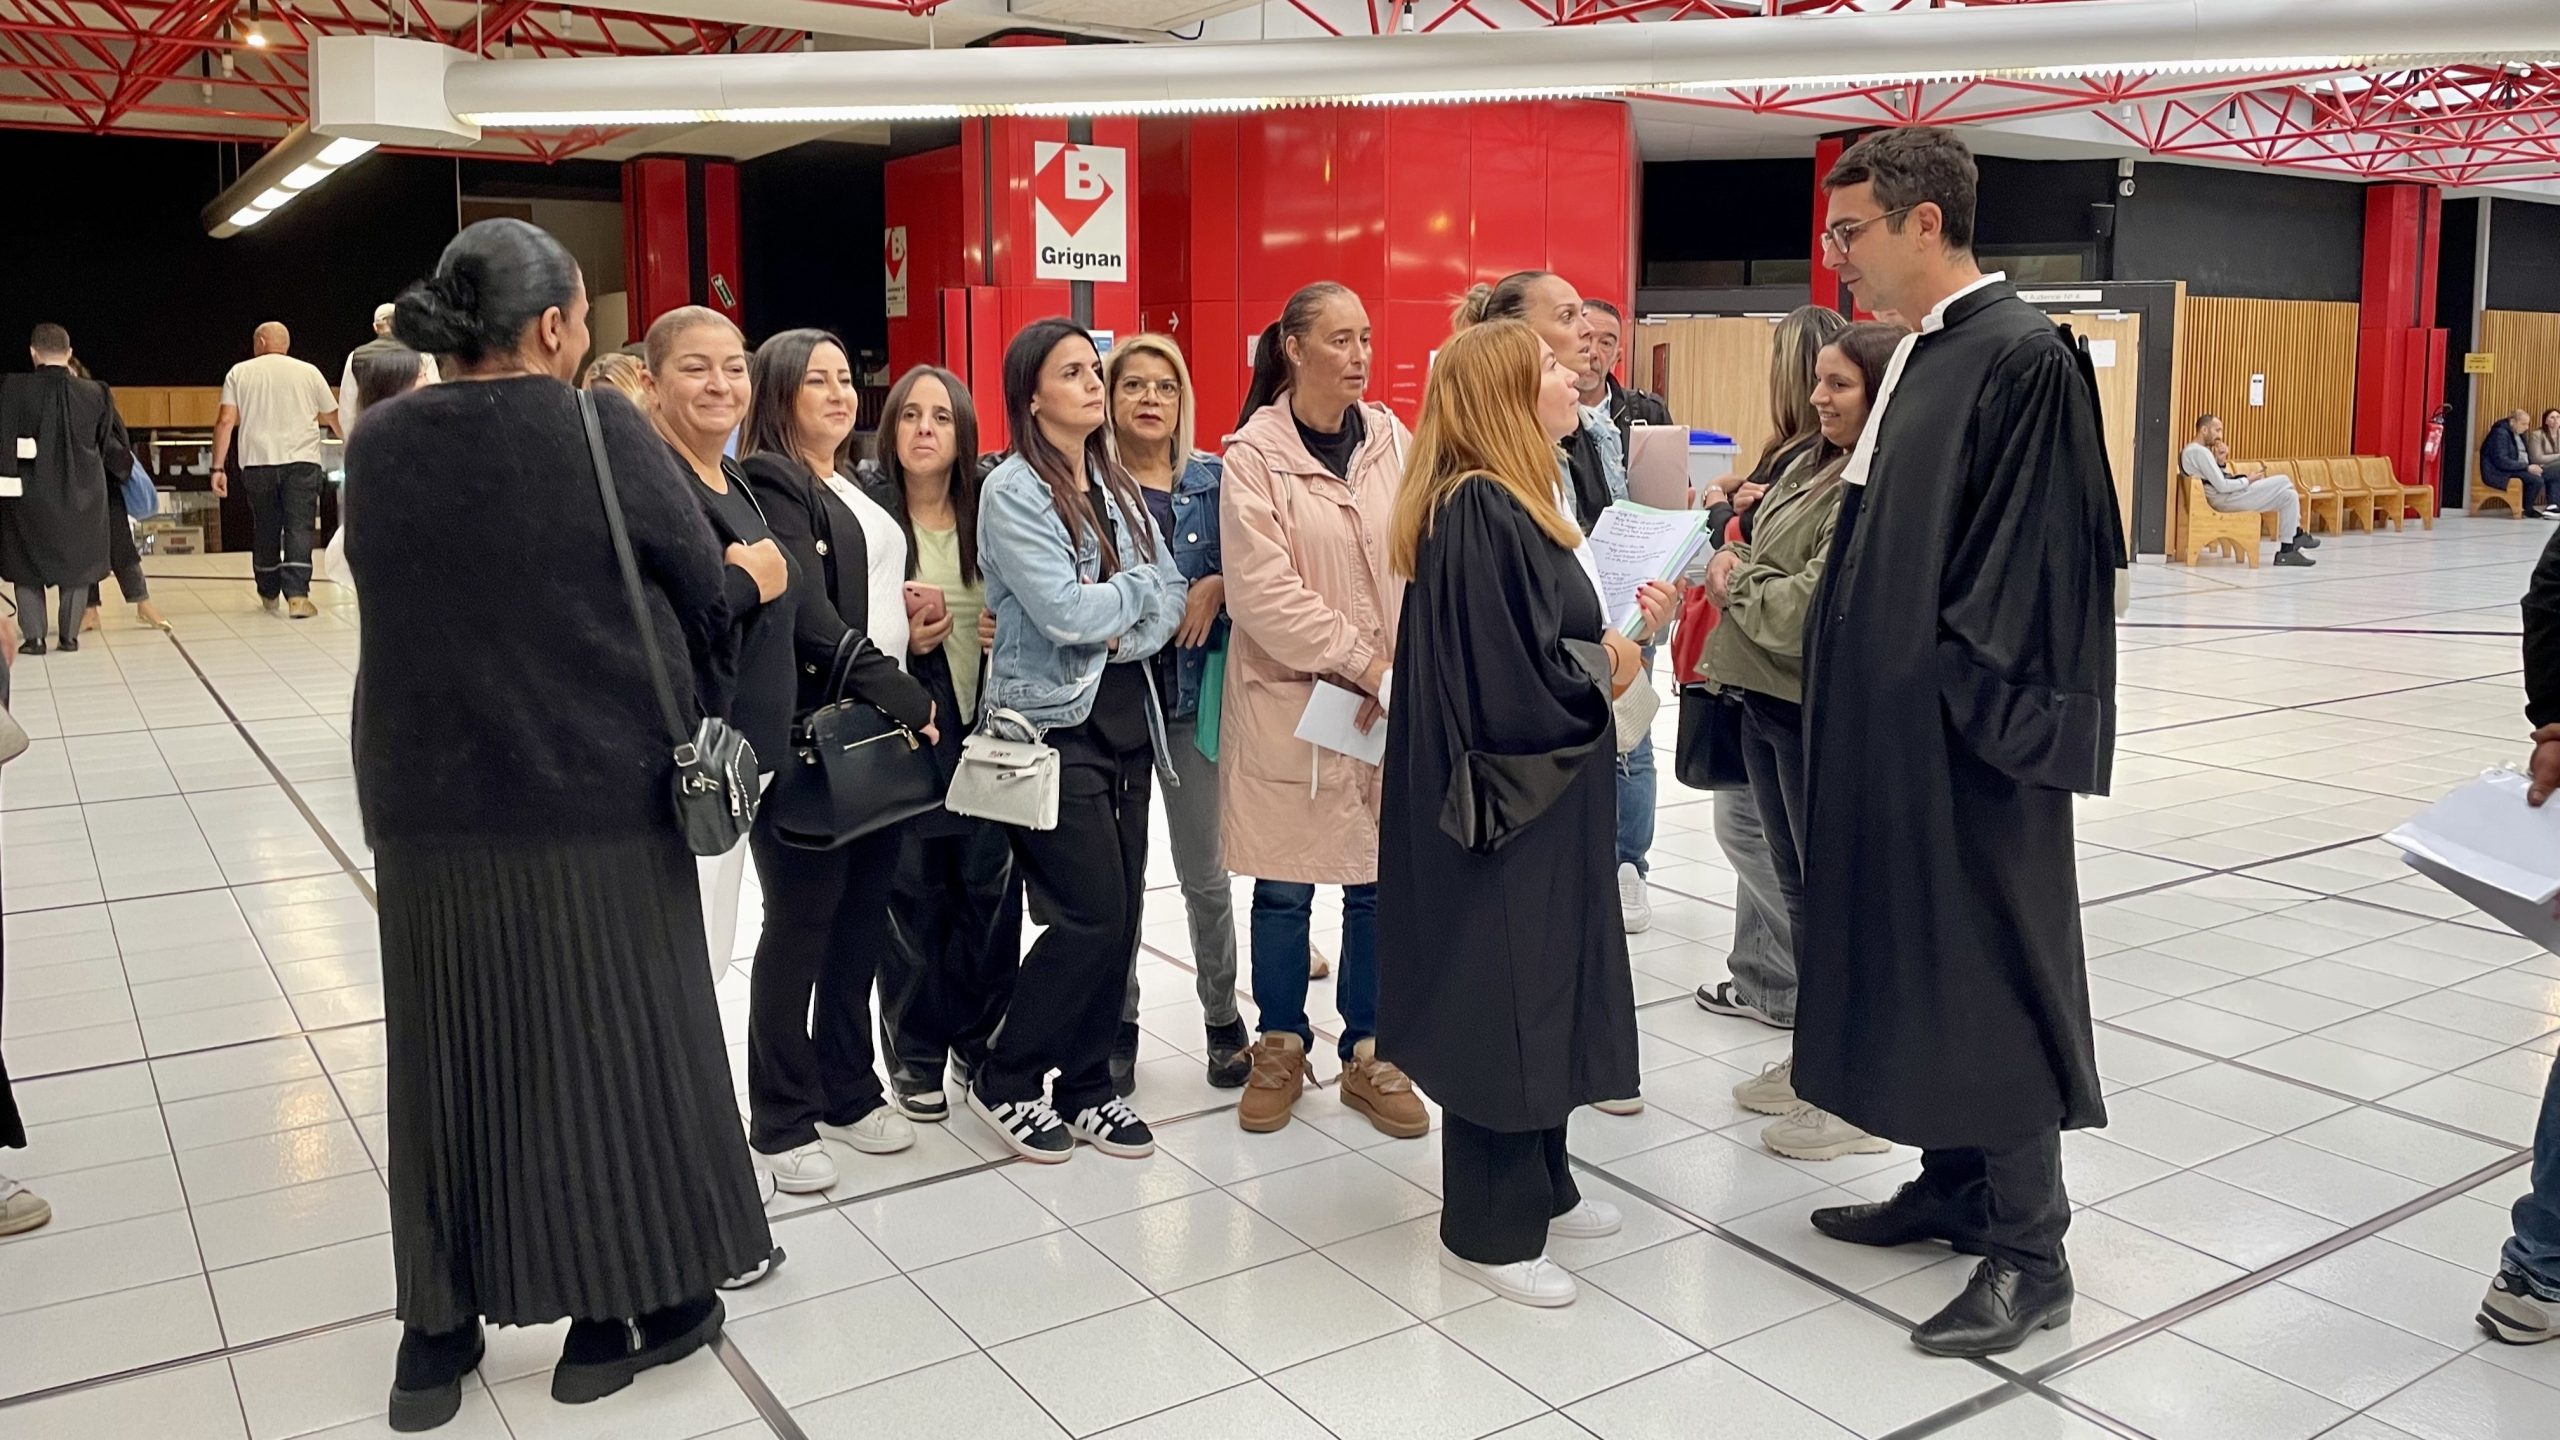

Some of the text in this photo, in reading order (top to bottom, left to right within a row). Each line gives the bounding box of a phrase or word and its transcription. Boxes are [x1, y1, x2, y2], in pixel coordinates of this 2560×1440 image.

[1064, 149, 1105, 200] B
[891, 229, 904, 262] B
[1041, 246, 1122, 269] Grignan
